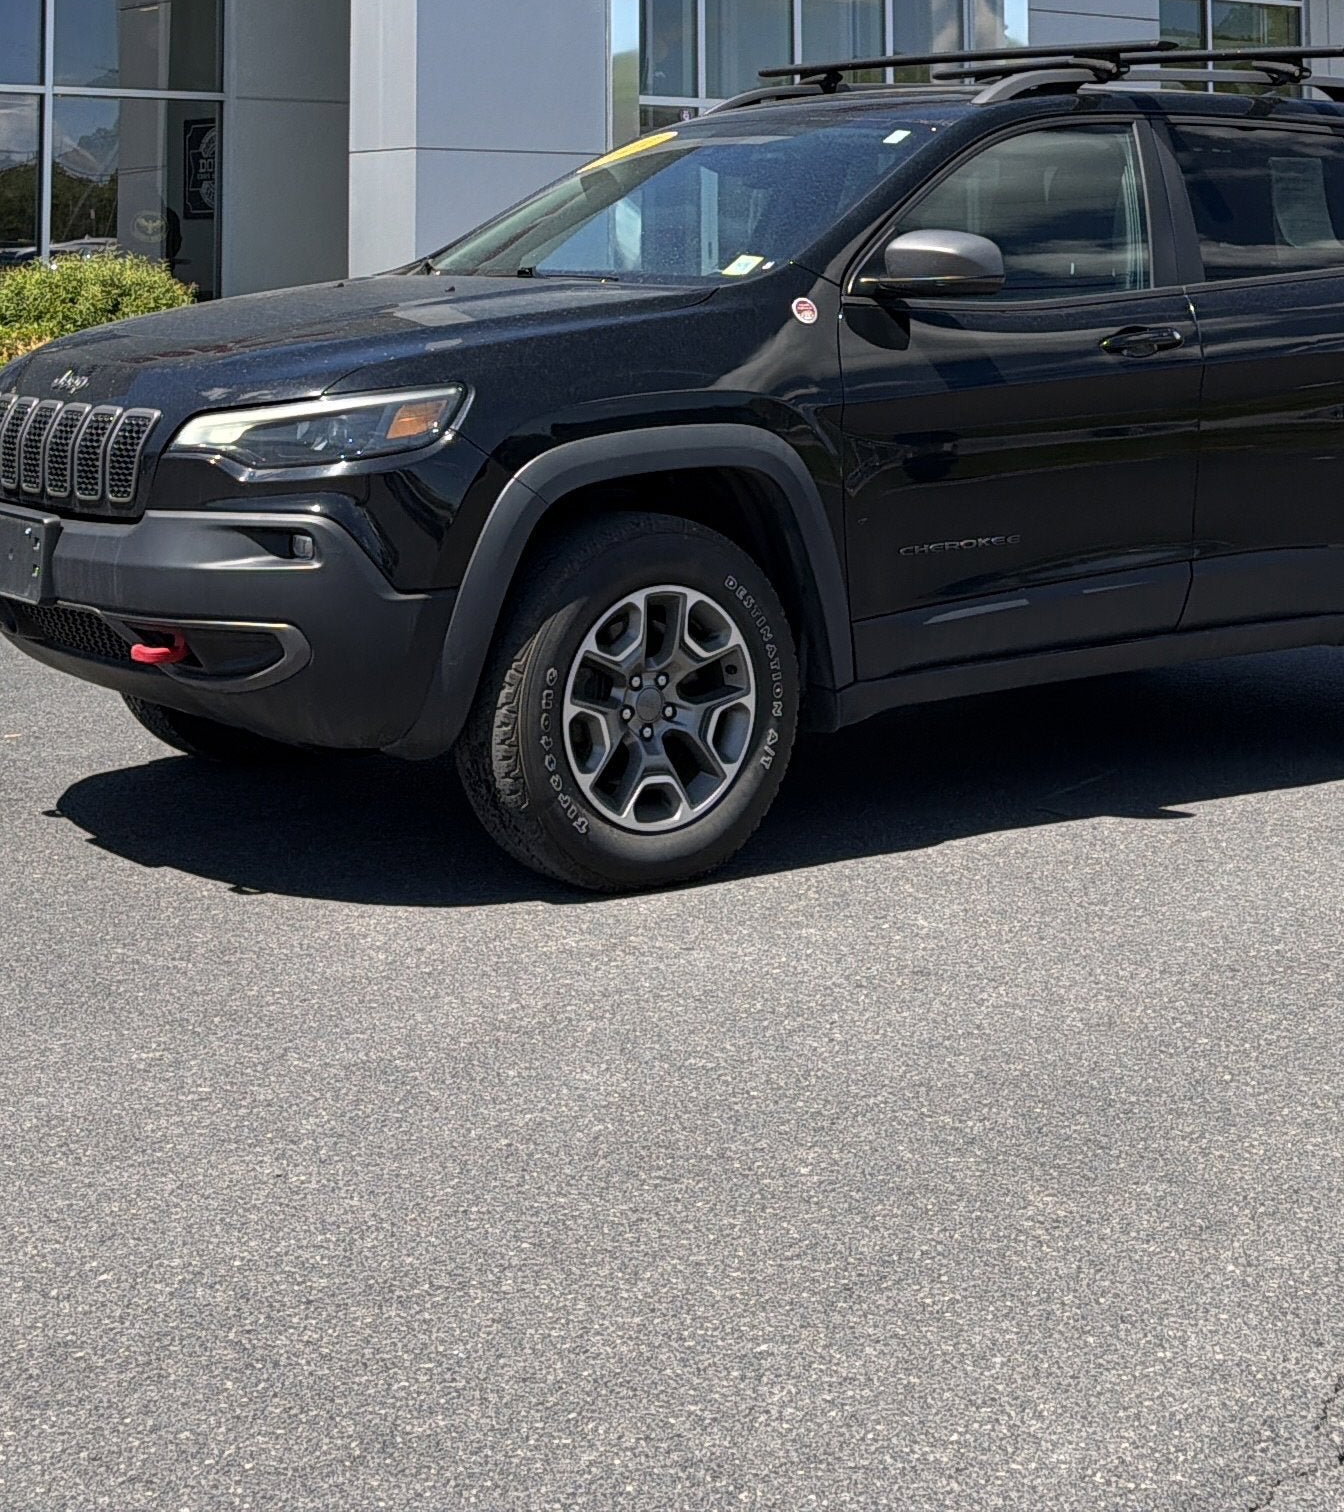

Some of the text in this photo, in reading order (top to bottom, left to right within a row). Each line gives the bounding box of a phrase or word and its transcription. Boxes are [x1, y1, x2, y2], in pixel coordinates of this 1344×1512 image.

[899, 535, 1021, 555] CHEROKEE
[540, 667, 590, 834] Firestone
[724, 575, 784, 770] DESTINATION A/T
